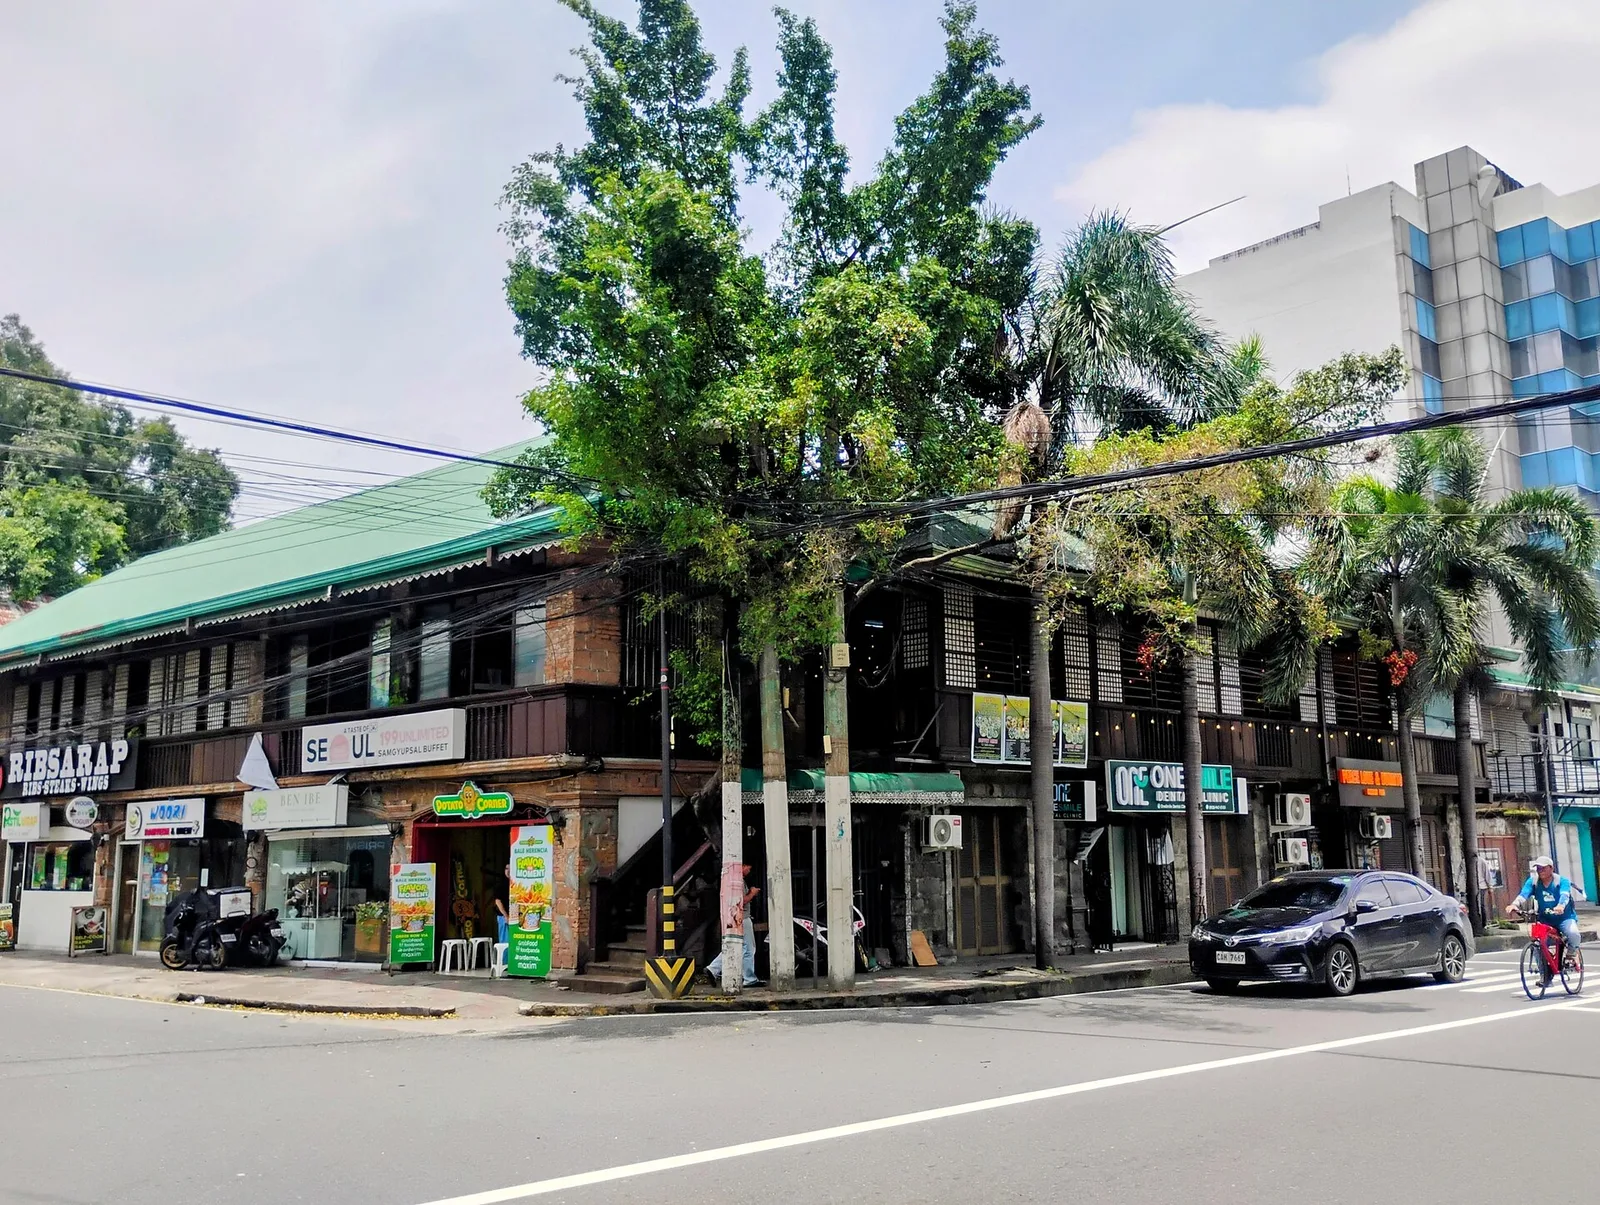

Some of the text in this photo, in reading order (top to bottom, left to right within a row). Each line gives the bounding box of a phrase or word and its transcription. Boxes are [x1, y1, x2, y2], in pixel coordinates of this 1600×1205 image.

[380, 726, 449, 745] 199 UNLIMITED
[378, 743, 448, 757] SAMGYUPSAL BUFFET
[7, 739, 128, 783] RIBSARAP
[1155, 791, 1229, 803] DENTA LINIC
[150, 805, 186, 819] WOORI
[517, 857, 545, 871] FLAVOR
[516, 869, 545, 879] MOMENT
[398, 884, 428, 893] FLAVOR
